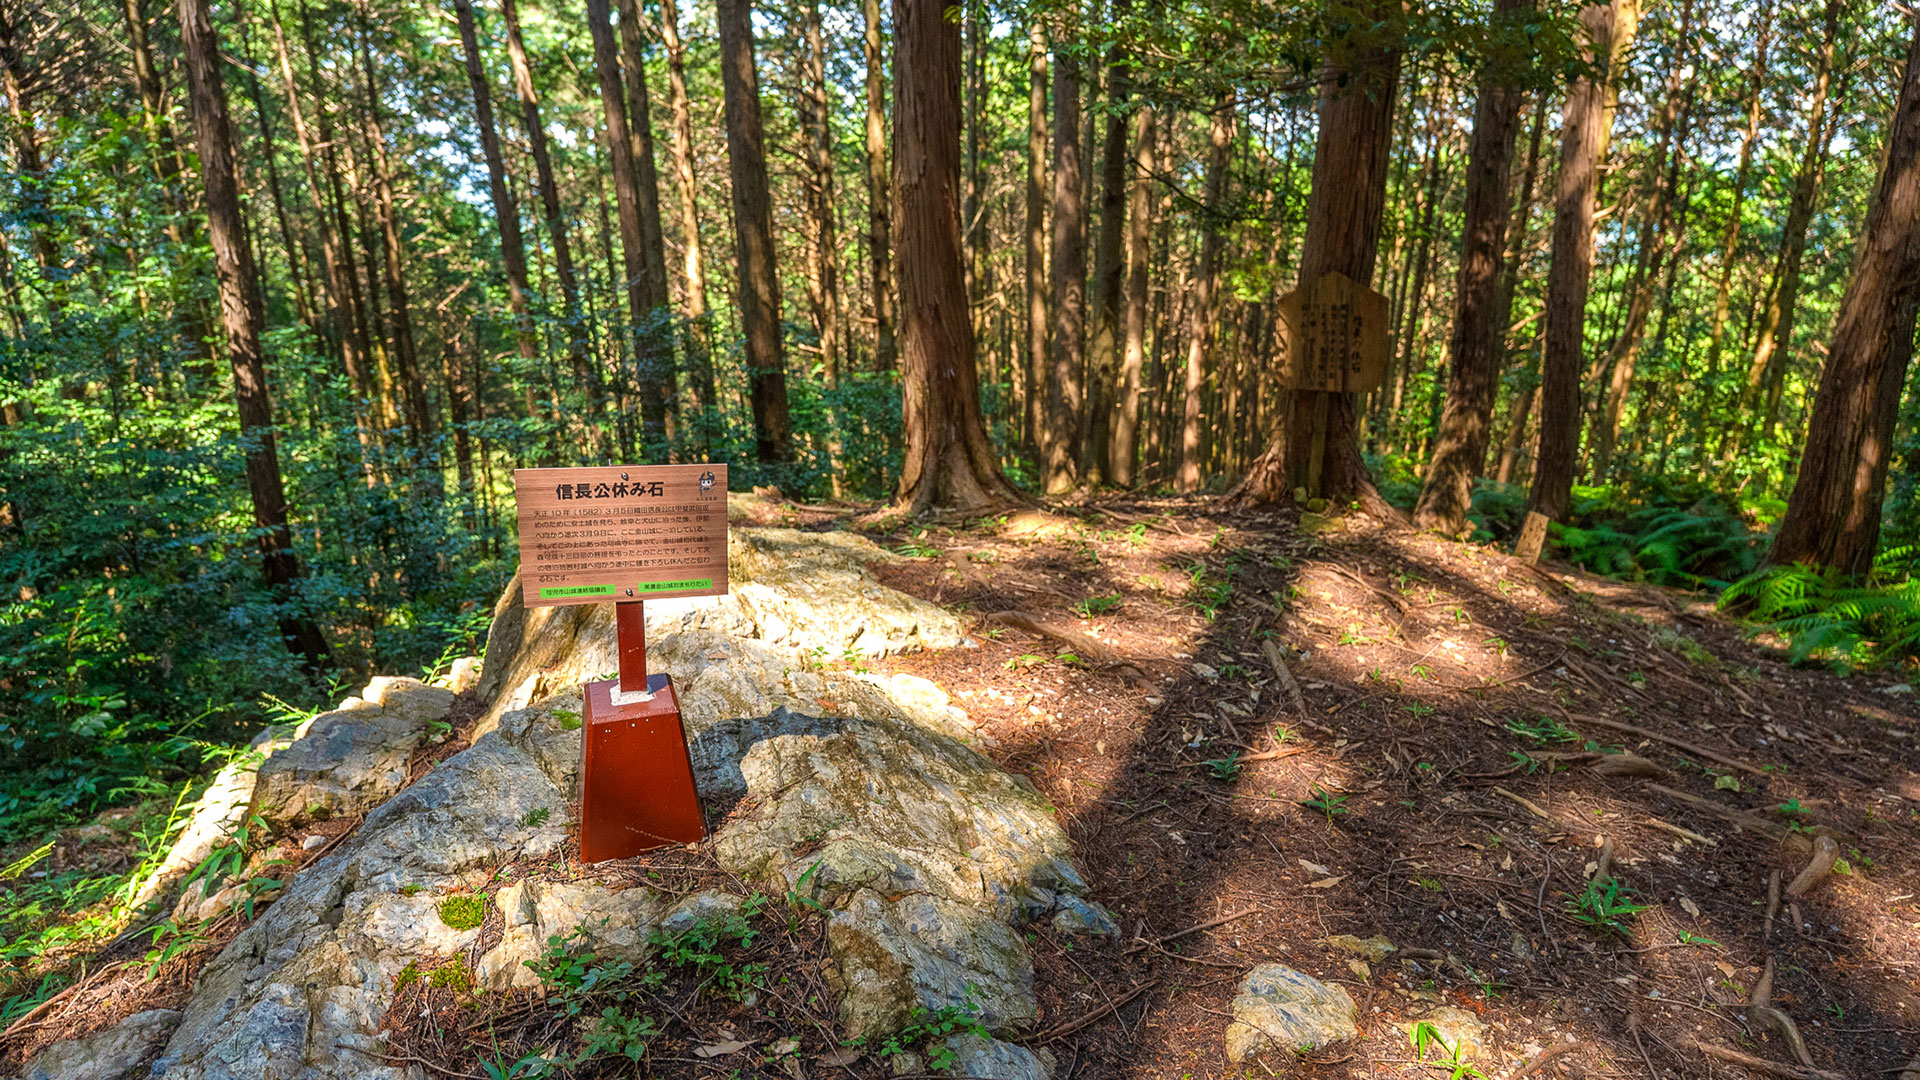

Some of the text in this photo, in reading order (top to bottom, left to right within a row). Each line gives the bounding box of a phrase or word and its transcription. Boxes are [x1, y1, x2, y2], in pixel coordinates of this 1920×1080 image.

[555, 481, 665, 500] 信長公休み石
